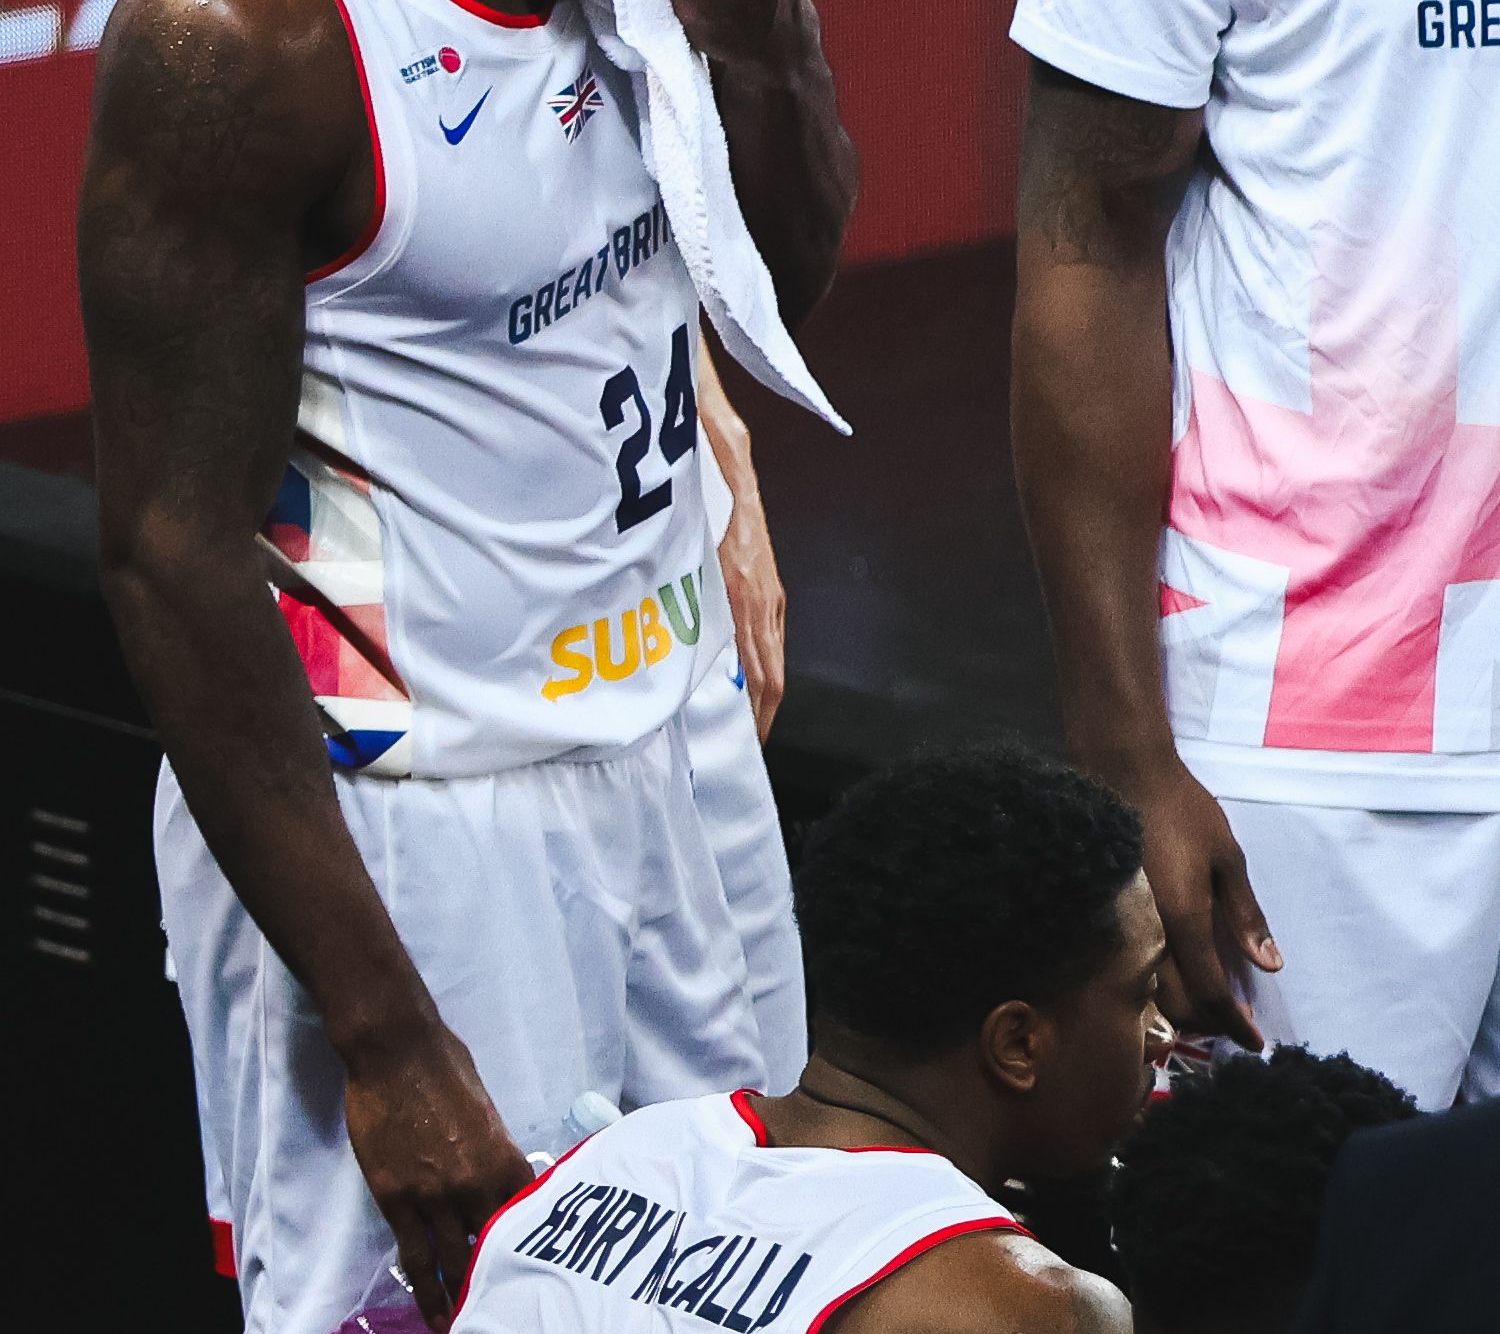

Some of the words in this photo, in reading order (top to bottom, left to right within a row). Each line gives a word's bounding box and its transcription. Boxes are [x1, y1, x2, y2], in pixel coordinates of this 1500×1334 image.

[507, 242, 610, 346] GREAT
[599, 322, 698, 535] 24
[513, 1181, 676, 1286] HENRY
